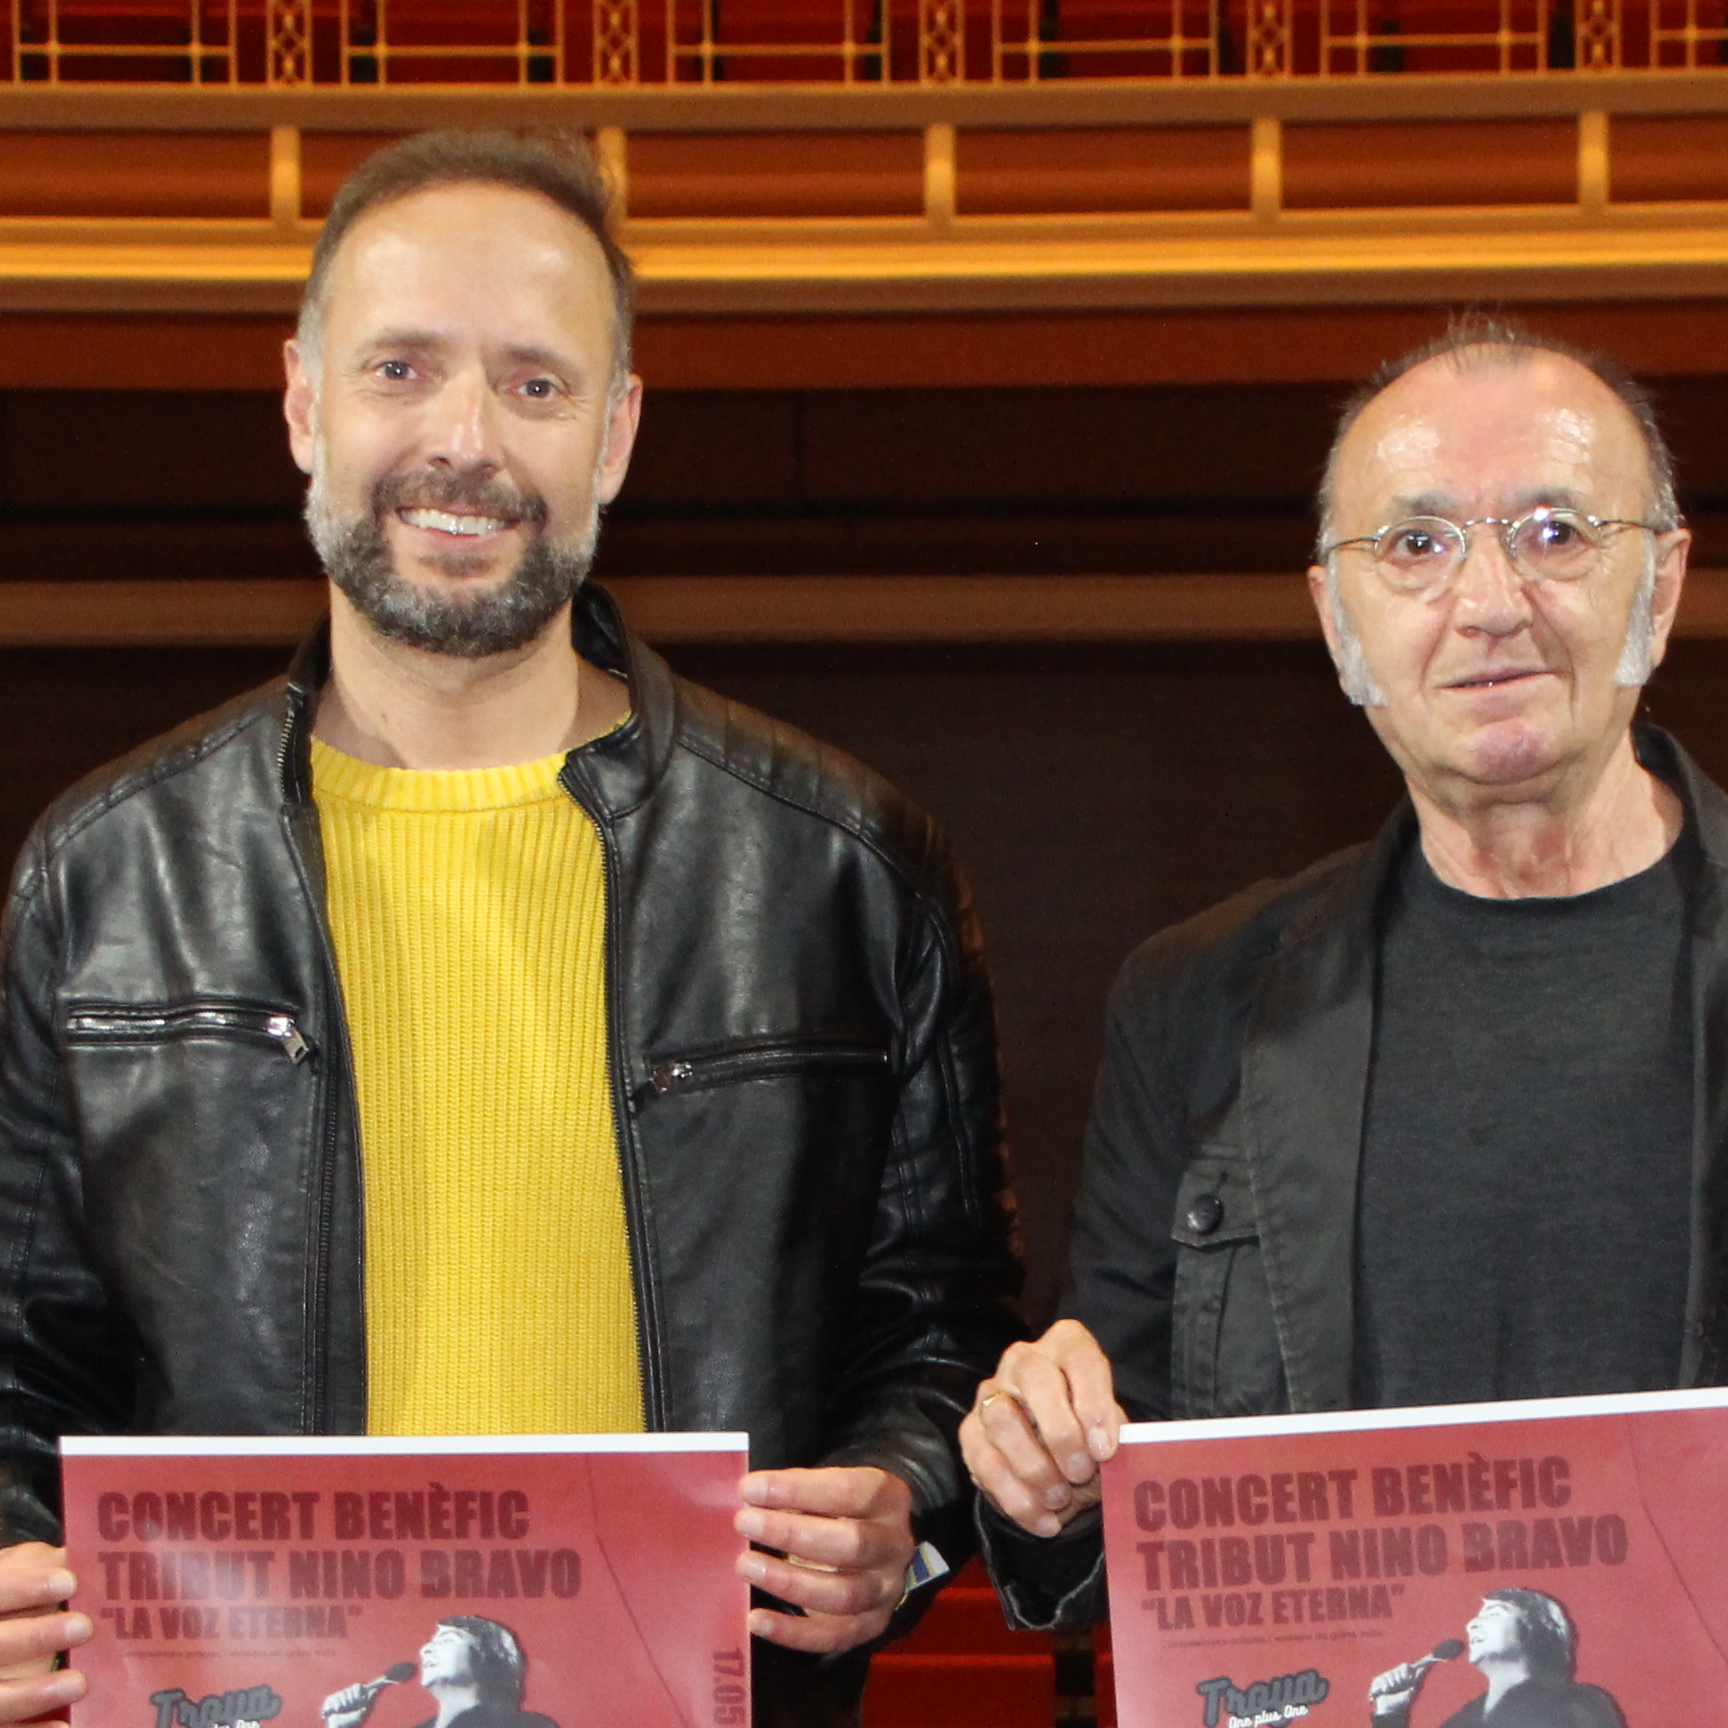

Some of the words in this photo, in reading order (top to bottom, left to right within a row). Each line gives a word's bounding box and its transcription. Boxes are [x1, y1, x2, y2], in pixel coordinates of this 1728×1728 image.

[97, 1490, 320, 1542] CONCERT
[1133, 1469, 1358, 1532] CONCERT
[98, 1550, 275, 1601] TRIBUT
[289, 1548, 407, 1600] NINO
[420, 1548, 582, 1600] BRAVO
[1136, 1532, 1314, 1591] TRIBUT
[1329, 1523, 1447, 1580] NINO
[1462, 1513, 1628, 1573] BRAVO
[160, 1606, 220, 1640] VOZ
[1203, 1593, 1264, 1628] VOZ
